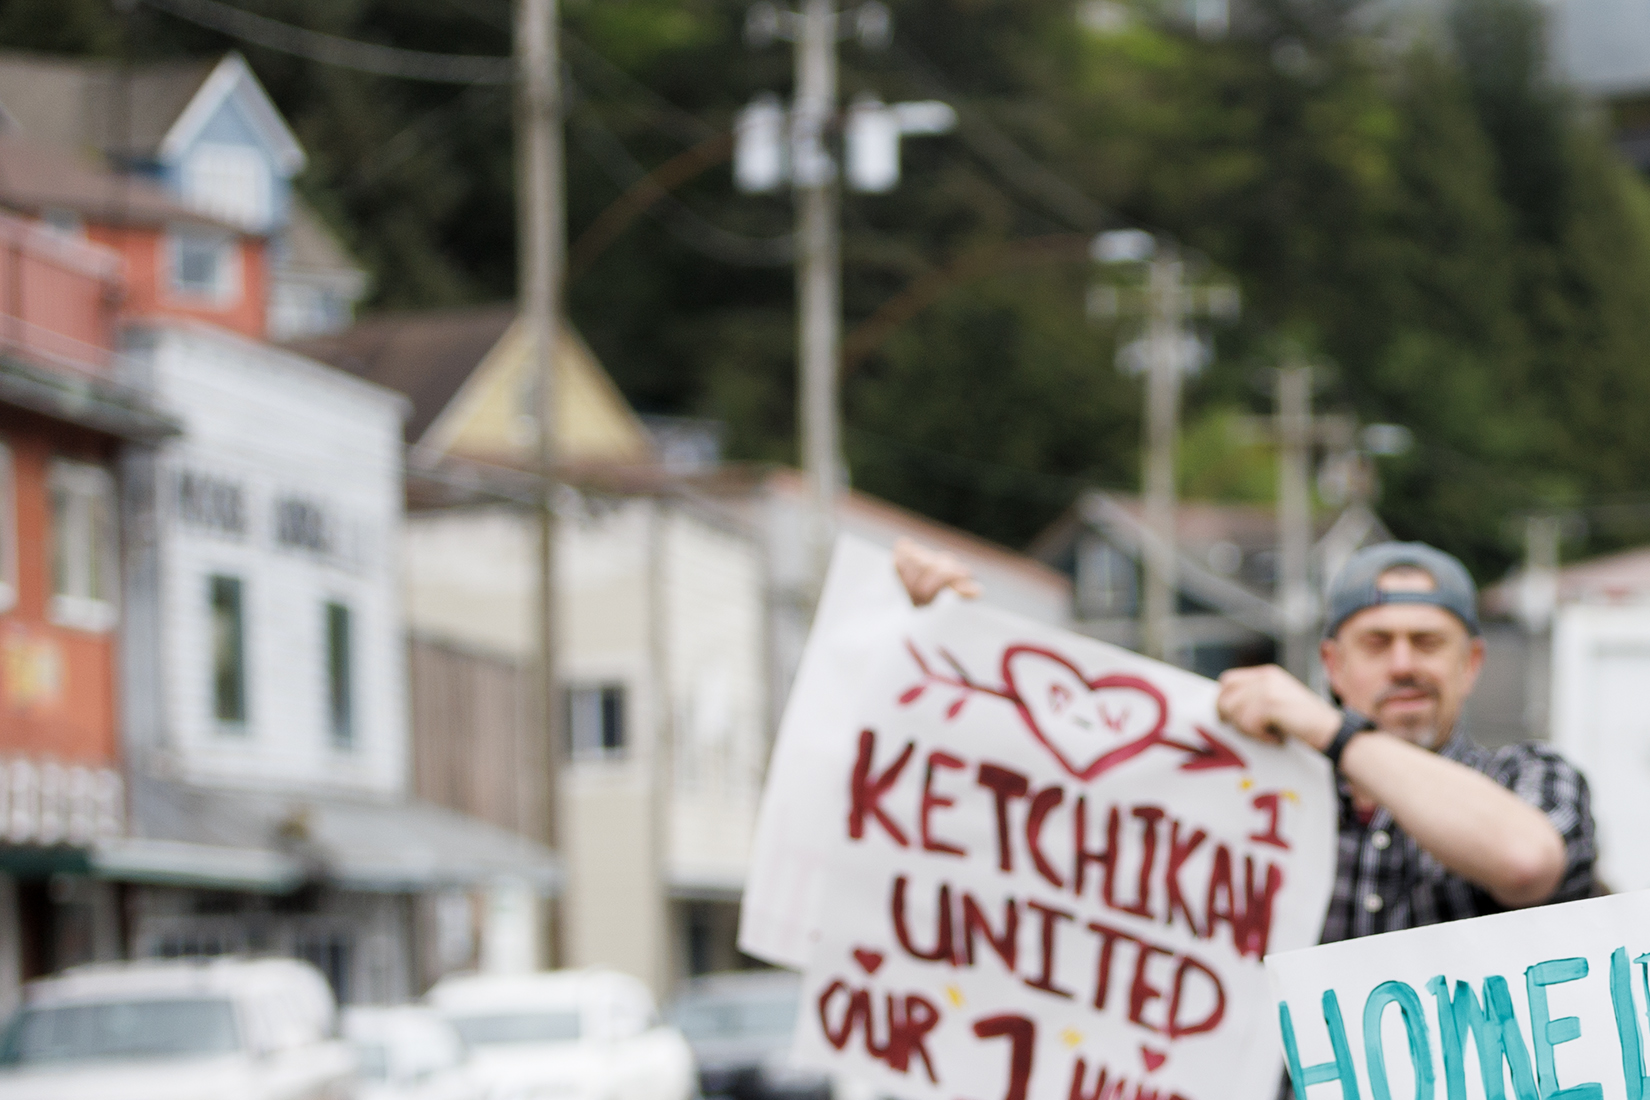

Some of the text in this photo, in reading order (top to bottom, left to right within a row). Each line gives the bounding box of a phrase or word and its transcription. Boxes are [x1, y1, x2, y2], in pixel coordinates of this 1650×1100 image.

[847, 729, 1283, 959] KETCHIKAN
[819, 980, 940, 1084] OUR
[892, 875, 1228, 1041] UNITED
